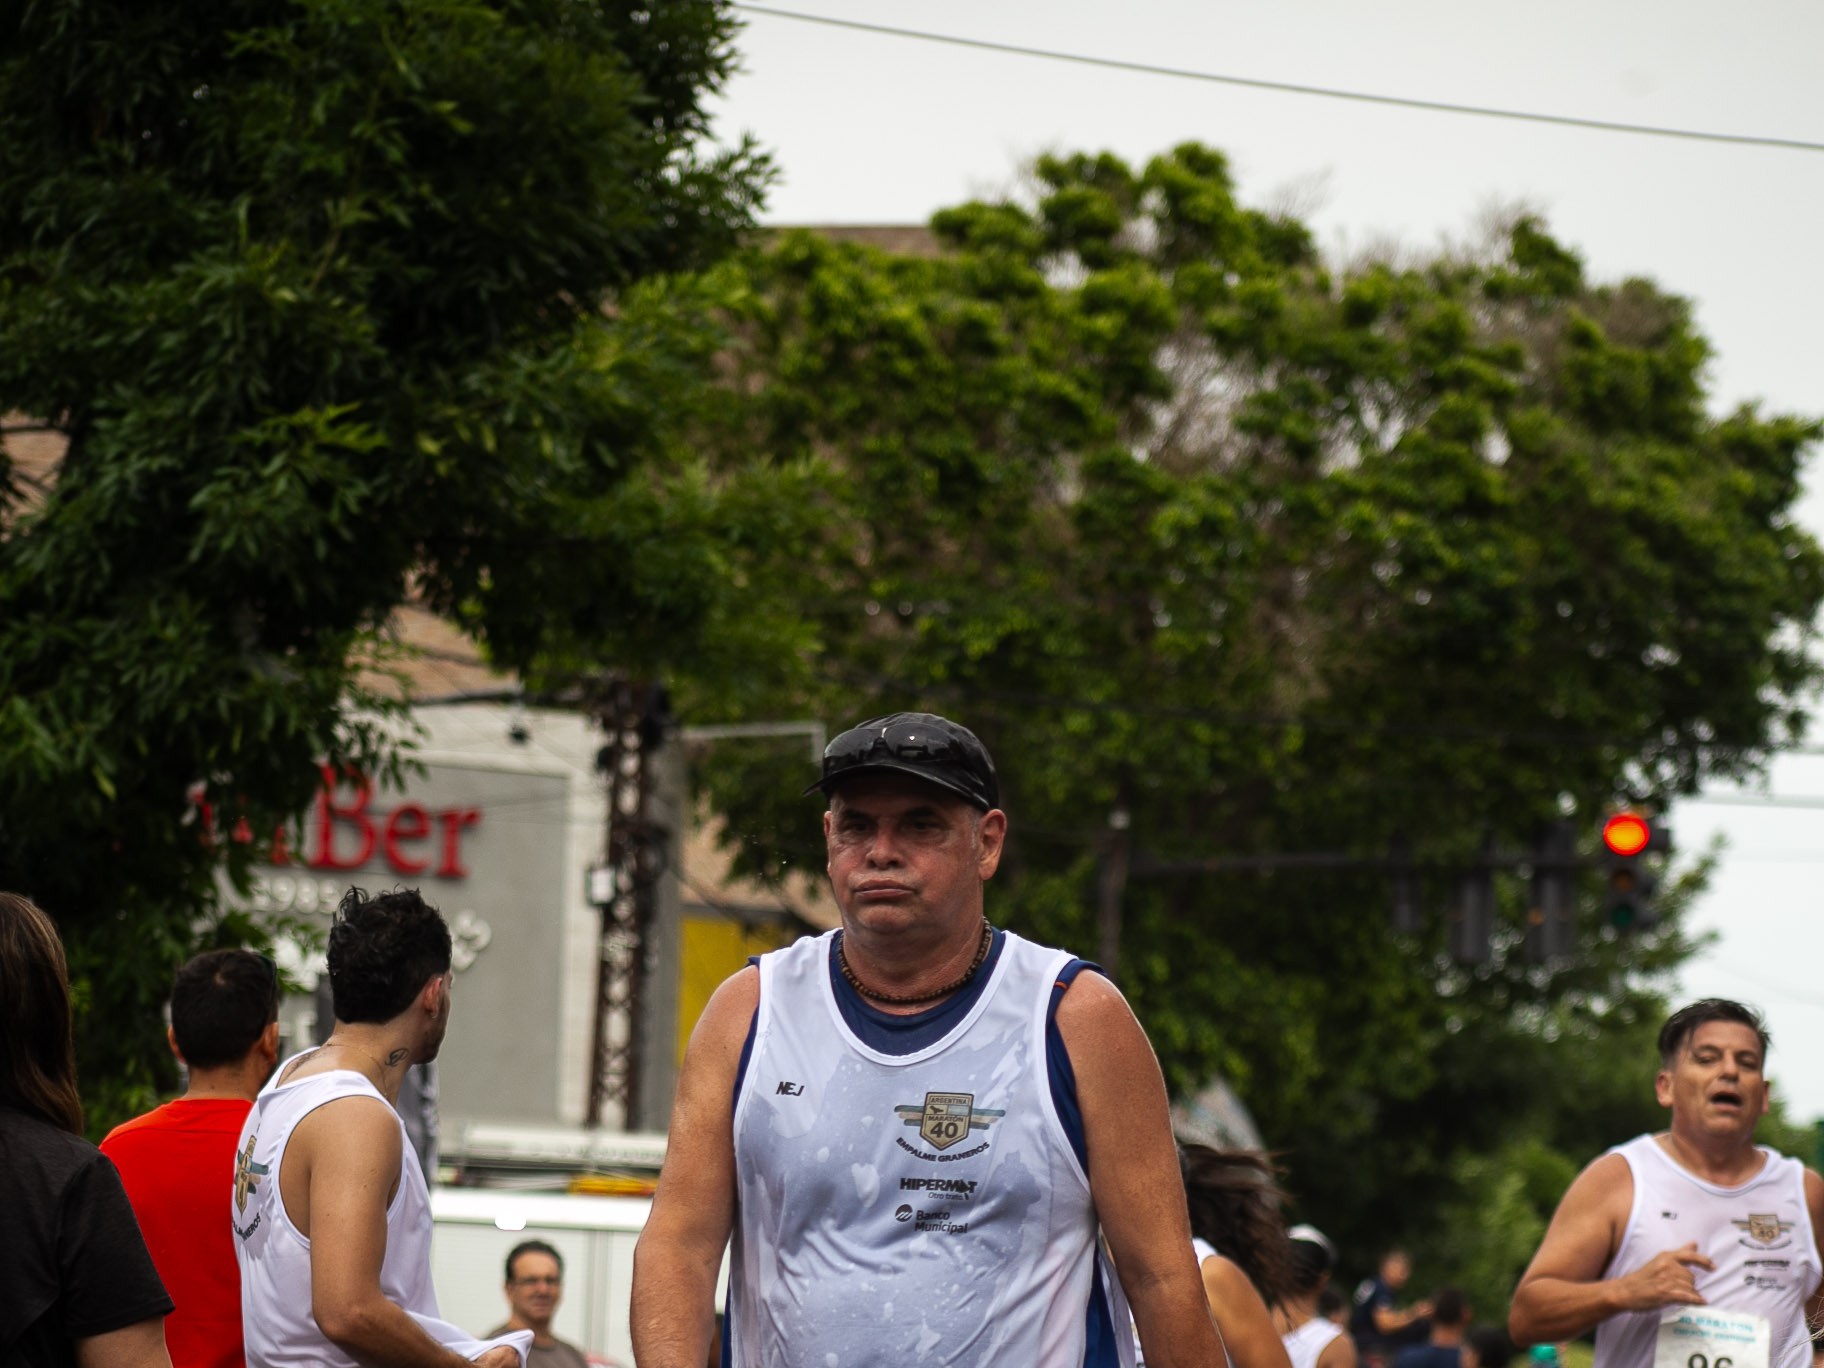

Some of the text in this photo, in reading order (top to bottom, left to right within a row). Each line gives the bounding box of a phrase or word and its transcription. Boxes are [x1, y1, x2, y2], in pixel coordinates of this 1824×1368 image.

[776, 1081, 805, 1096] NEJ
[930, 1097, 968, 1105] ARGENTINA
[930, 1122, 959, 1139] 40
[896, 1137, 990, 1162] EMPALME GRANEROS
[916, 1209, 950, 1220] Banco
[915, 1221, 968, 1235] Municipal
